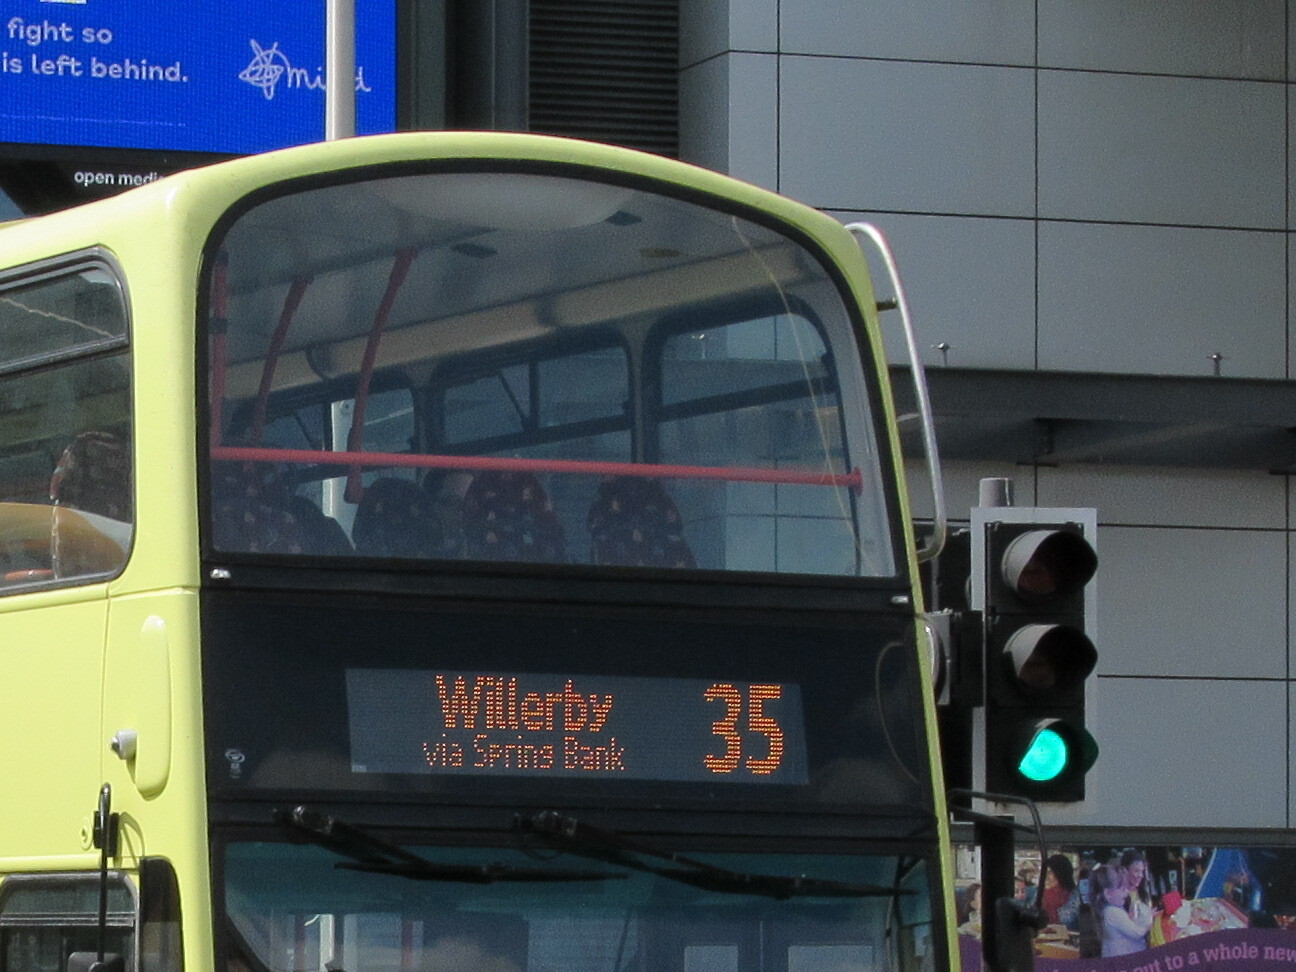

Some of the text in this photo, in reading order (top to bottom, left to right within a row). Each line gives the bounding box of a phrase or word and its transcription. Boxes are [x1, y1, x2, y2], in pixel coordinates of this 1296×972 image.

[7, 17, 74, 46] fight
[81, 27, 114, 45] so
[2, 51, 23, 74] is
[31, 54, 83, 77] left
[90, 57, 189, 83] behind.
[287, 65, 372, 92] mid
[74, 170, 115, 187] open
[434, 673, 785, 775] Willerby 35
[422, 733, 464, 768] via
[564, 735, 626, 771] Bank
[1164, 953, 1184, 971] to
[1188, 951, 1200, 965] a
[1203, 942, 1258, 962] whole
